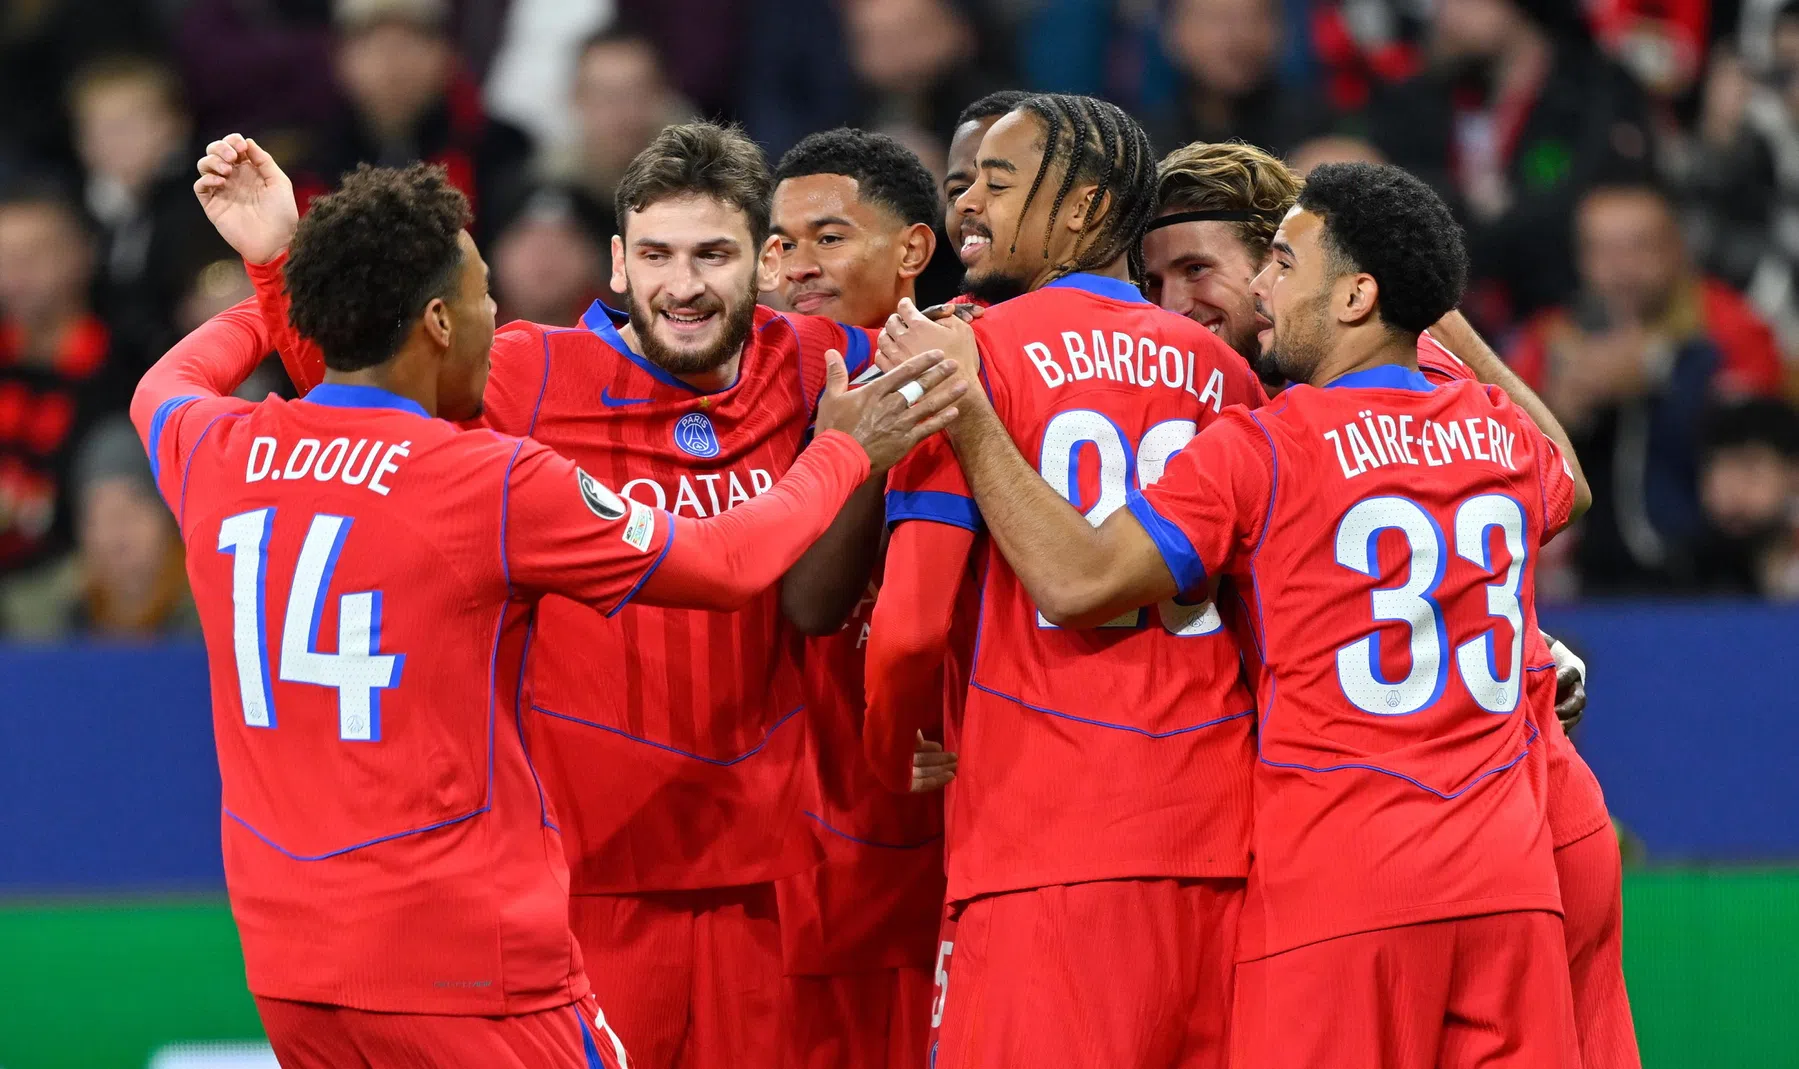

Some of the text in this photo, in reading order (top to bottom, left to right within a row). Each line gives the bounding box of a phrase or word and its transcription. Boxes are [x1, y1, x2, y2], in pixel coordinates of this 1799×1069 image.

[1023, 329, 1225, 414] B.BARCOLA
[681, 415, 708, 429] PARIS
[245, 436, 412, 497] D.DOUÉ
[216, 506, 407, 742] 14
[1333, 492, 1529, 717] 33
